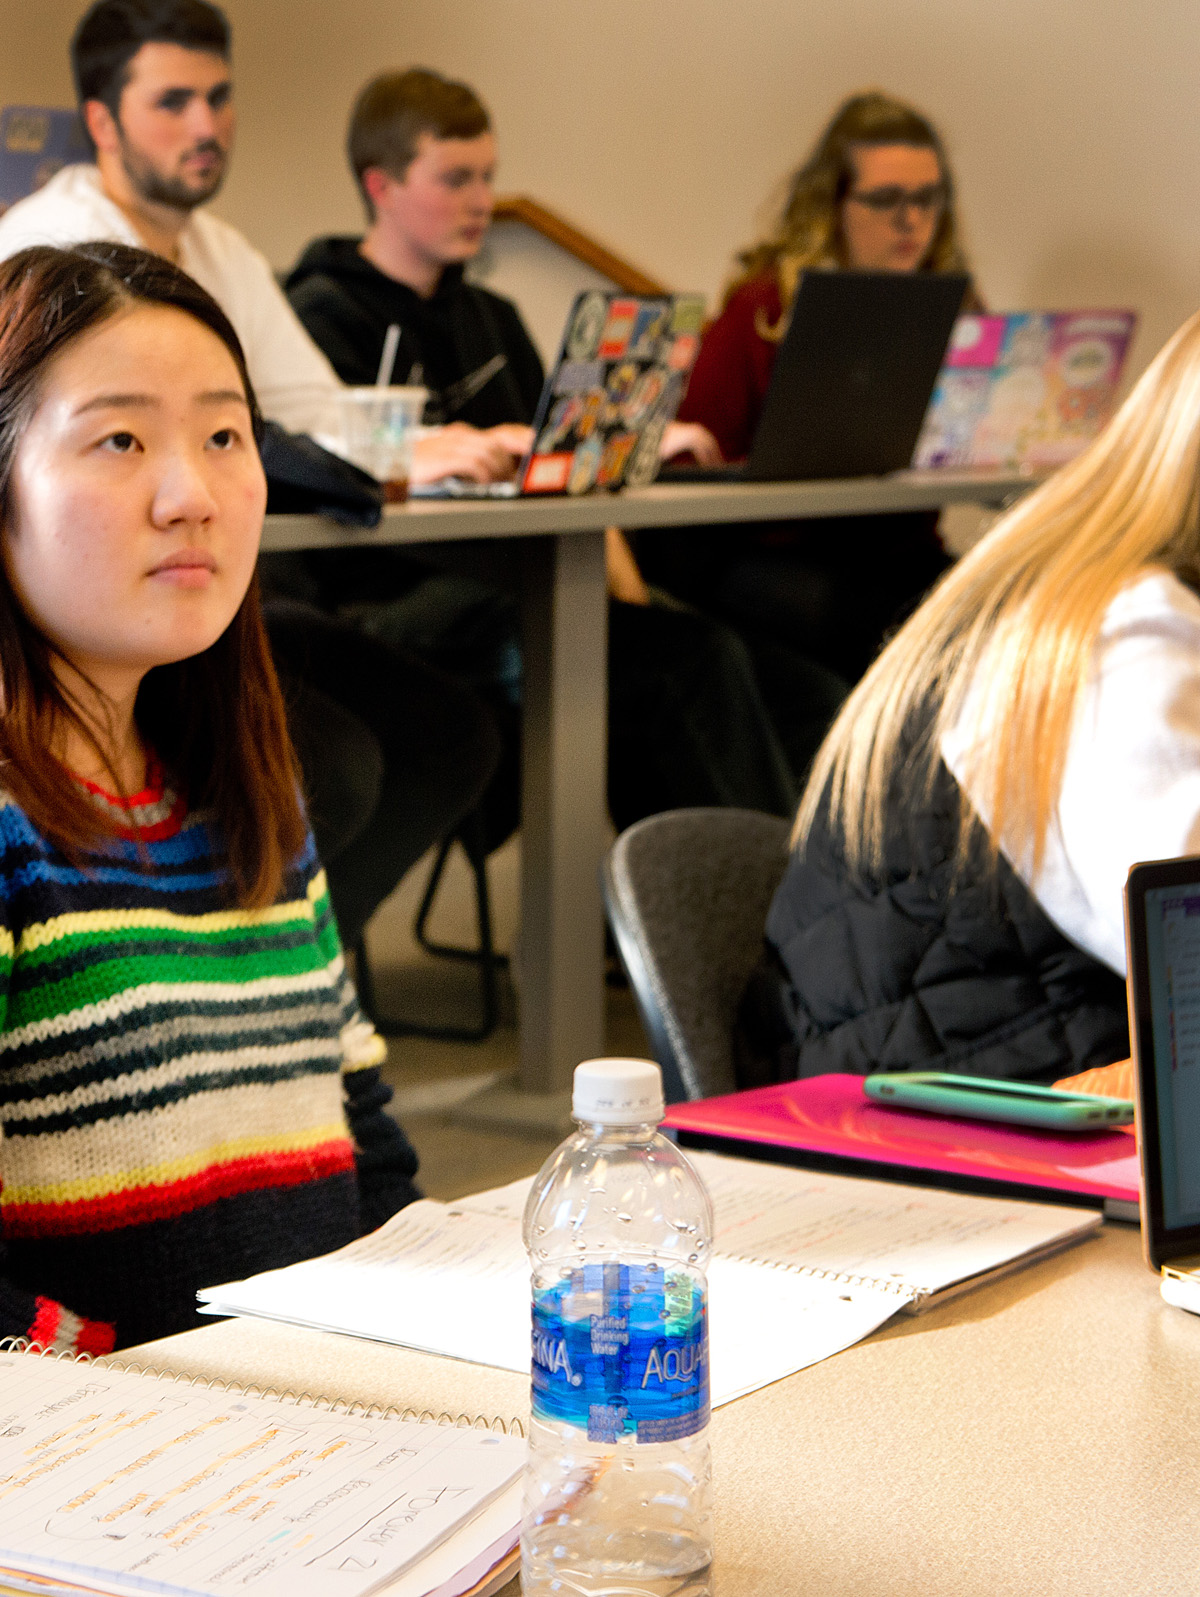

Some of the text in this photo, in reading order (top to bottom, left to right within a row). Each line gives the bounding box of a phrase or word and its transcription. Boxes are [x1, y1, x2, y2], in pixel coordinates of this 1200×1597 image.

[590, 1315, 626, 1330] Purified
[590, 1329, 629, 1346] Drinking
[590, 1343, 620, 1356] Water
